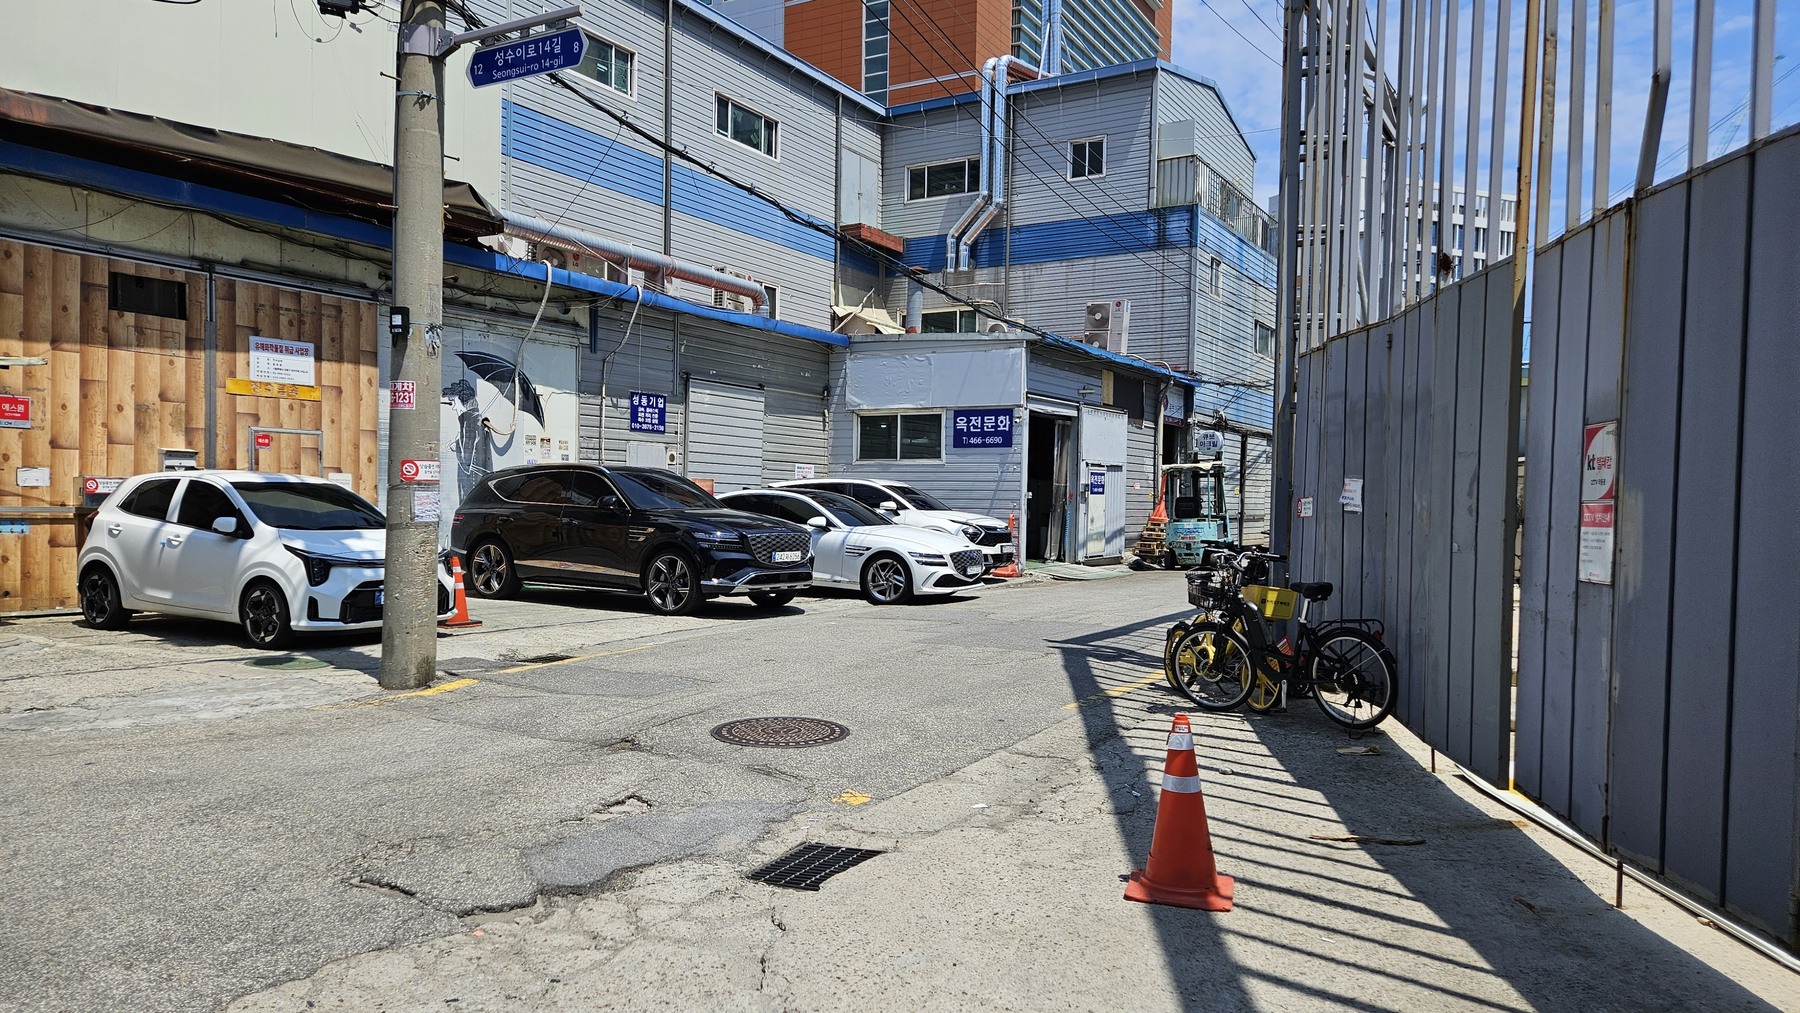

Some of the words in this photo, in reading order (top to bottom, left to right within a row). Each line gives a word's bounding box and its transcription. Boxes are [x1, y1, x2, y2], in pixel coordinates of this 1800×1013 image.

[494, 36, 561, 66] 성수이로14길
[573, 41, 580, 53] 8
[474, 63, 483, 75] 12
[492, 61, 539, 80] Seongsui-ro
[541, 54, 564, 69] 14-gil
[1, 403, 25, 413] 에스원
[632, 394, 664, 408] 성동기업
[955, 415, 1010, 432] 옥전문화
[1587, 454, 1596, 471] kt
